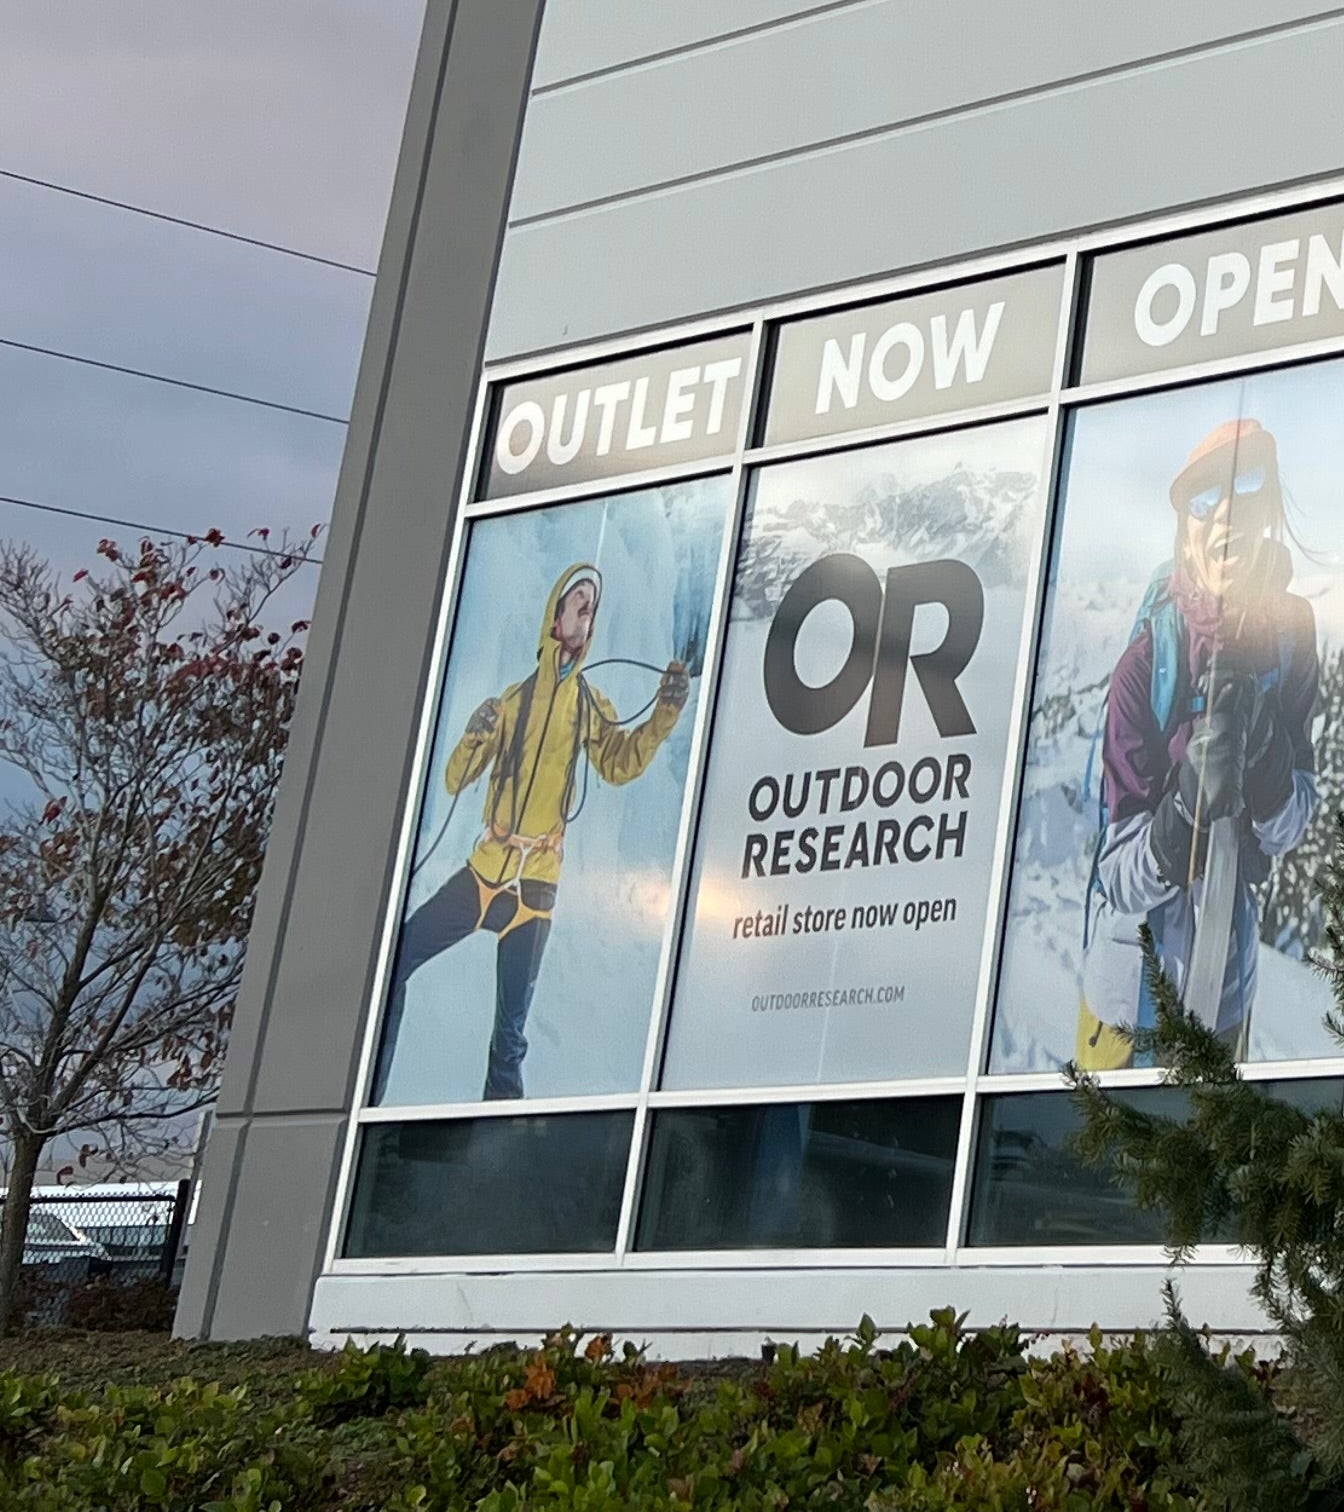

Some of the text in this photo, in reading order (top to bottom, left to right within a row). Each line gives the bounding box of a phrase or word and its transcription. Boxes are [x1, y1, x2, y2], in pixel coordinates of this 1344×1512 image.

[495, 356, 743, 475] OUTLET
[814, 300, 1007, 415] NOW
[763, 552, 985, 748] OR
[748, 753, 972, 823] OUTDOOR
[741, 810, 968, 879] RESEARCH
[732, 897, 957, 939] retail store now open
[751, 985, 906, 1013] OUTDOORRESEARCH.COM
